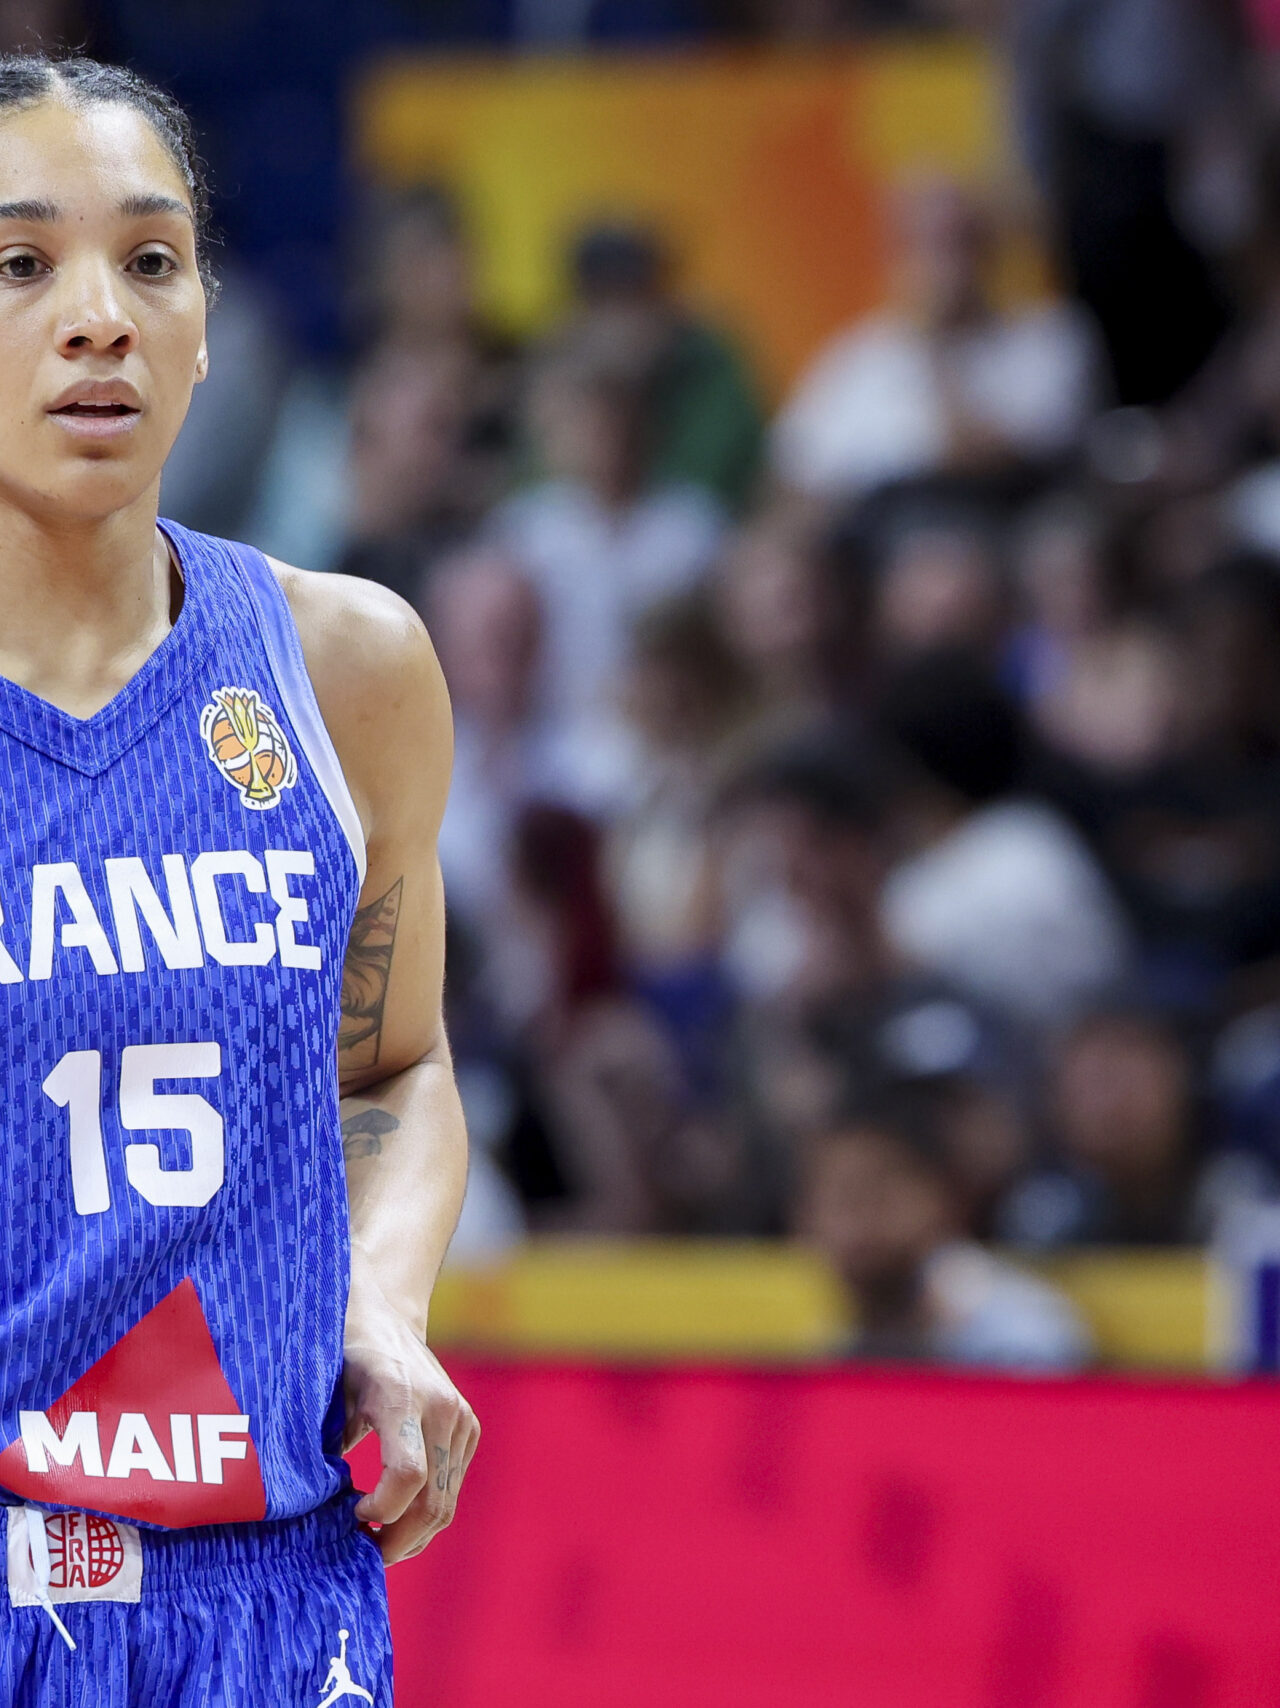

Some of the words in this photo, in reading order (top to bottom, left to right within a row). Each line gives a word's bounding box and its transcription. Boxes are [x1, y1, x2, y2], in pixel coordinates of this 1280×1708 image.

[42, 1041, 223, 1216] 15
[20, 1410, 250, 1484] MAIF
[68, 1512, 86, 1588] FRA
